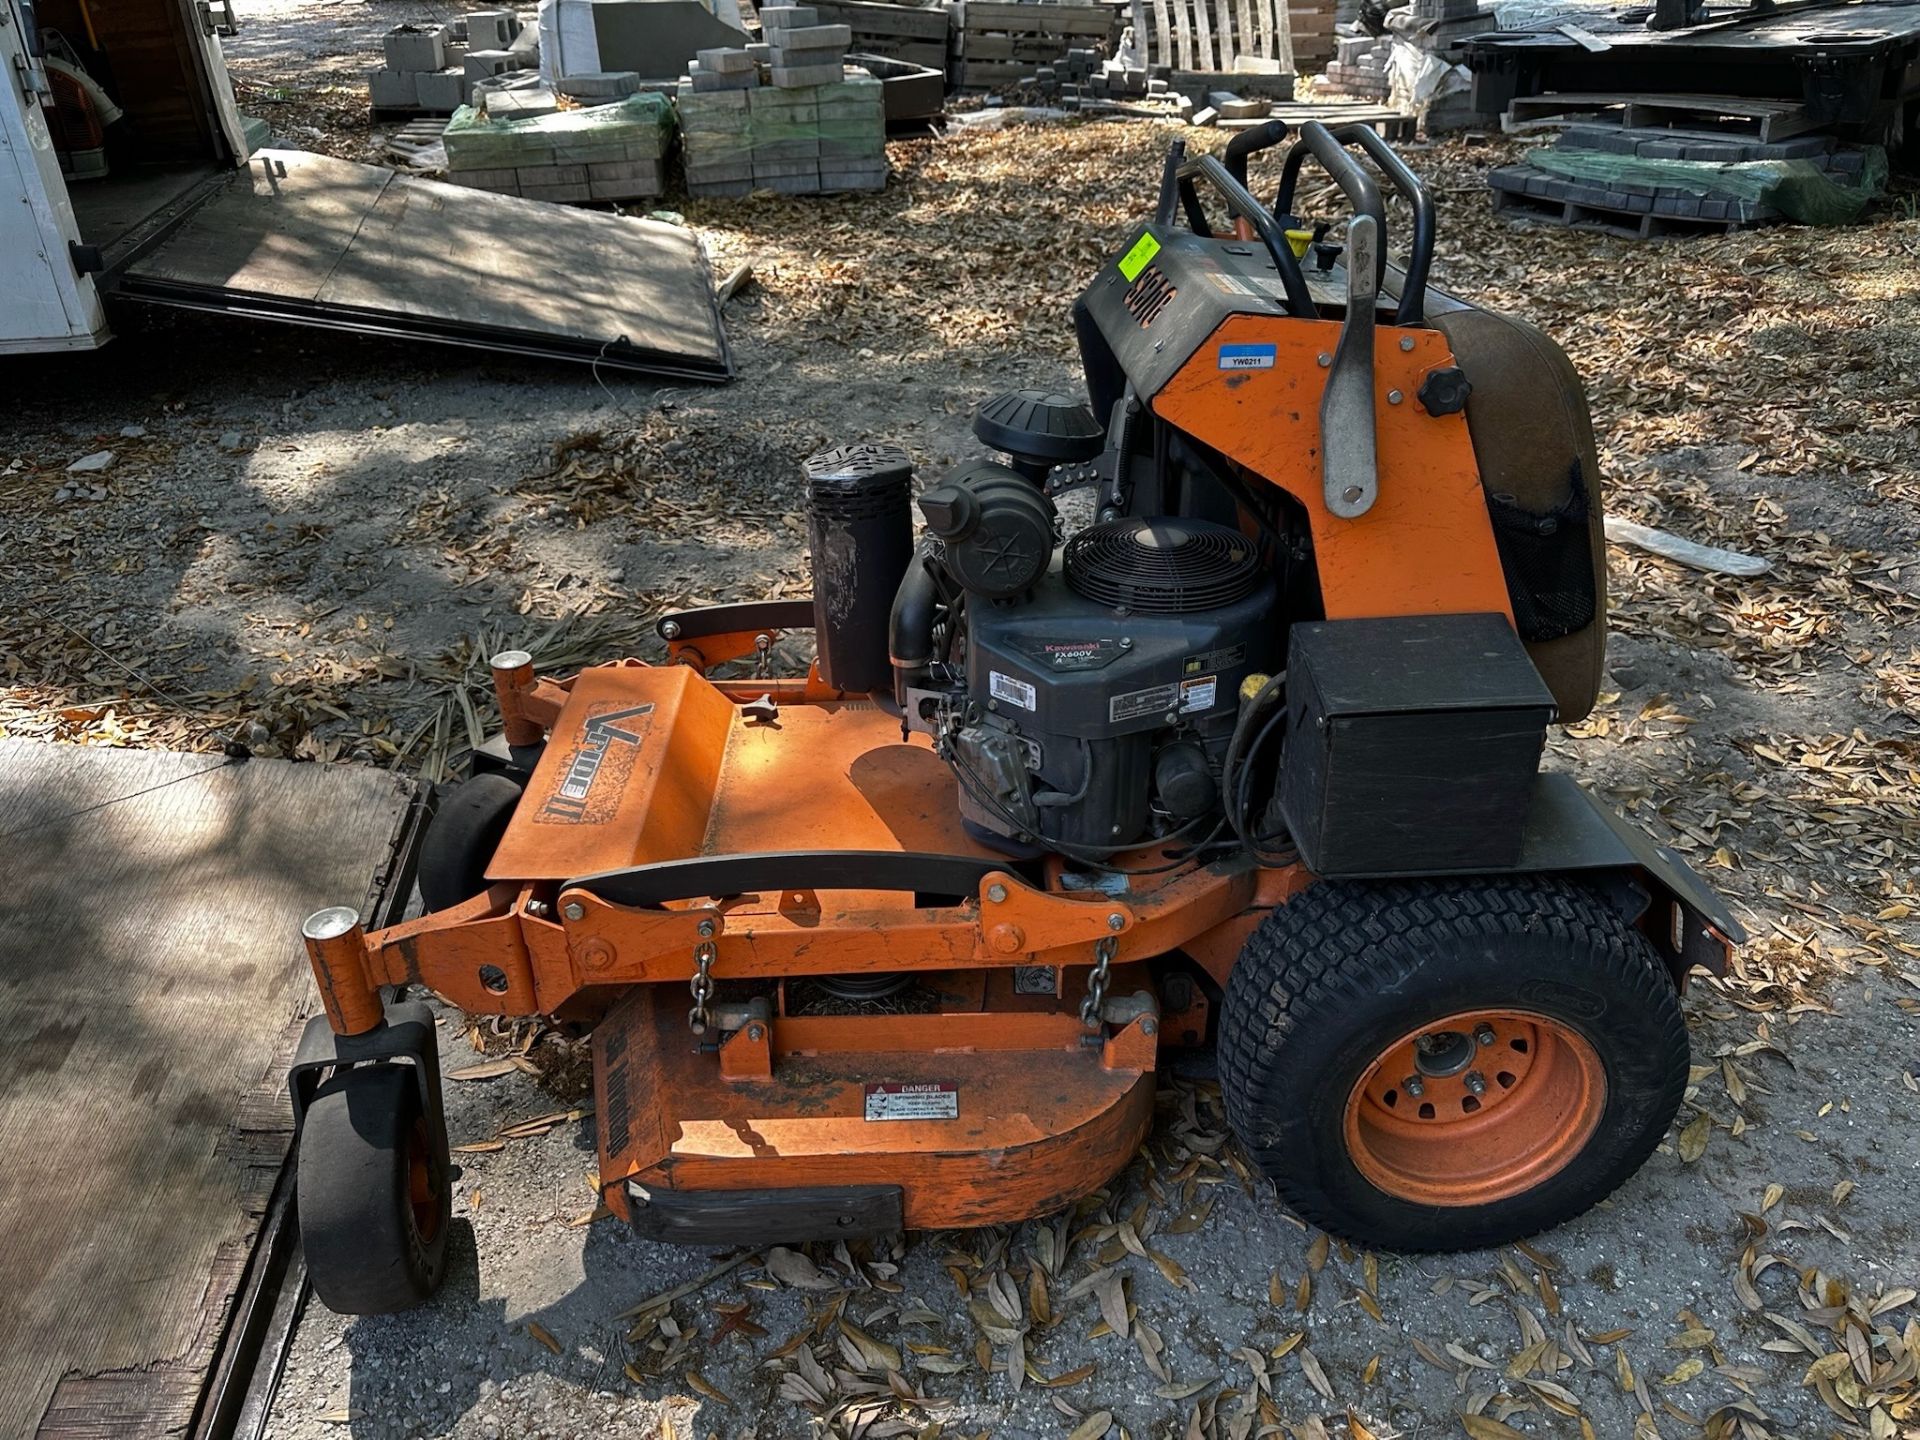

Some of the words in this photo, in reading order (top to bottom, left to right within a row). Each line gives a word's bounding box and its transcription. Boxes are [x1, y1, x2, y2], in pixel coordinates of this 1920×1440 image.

[1232, 358, 1261, 366] YW0211
[1055, 650, 1092, 658] FX600V
[901, 1084, 941, 1093] DANGER
